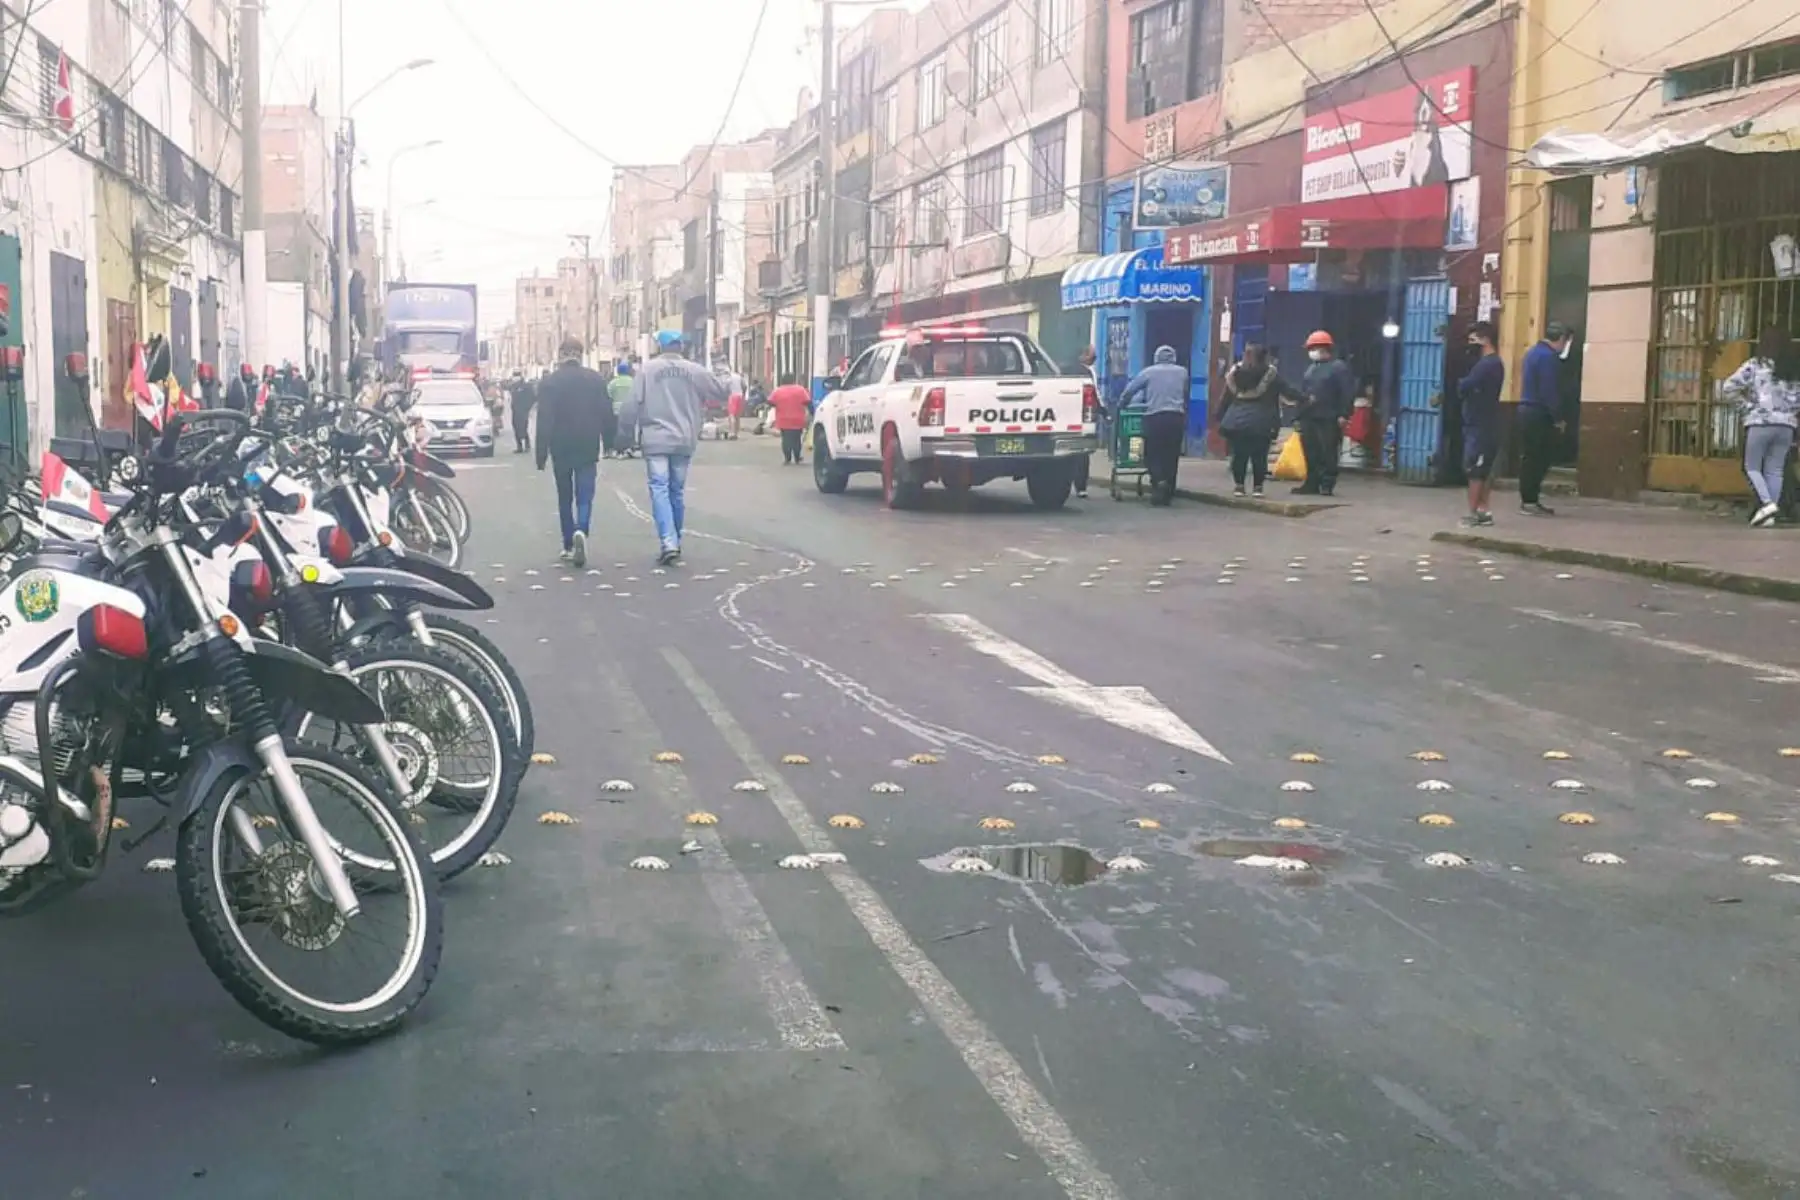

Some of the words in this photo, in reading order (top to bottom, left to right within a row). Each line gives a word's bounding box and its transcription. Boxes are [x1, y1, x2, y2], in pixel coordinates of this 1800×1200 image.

[1306, 121, 1363, 153] Ricocan
[1189, 234, 1238, 259] Ricocan
[1135, 258, 1150, 271] EL
[1140, 283, 1192, 295] MARINO
[848, 412, 875, 434] POLICIA
[968, 408, 1057, 423] POLICIA
